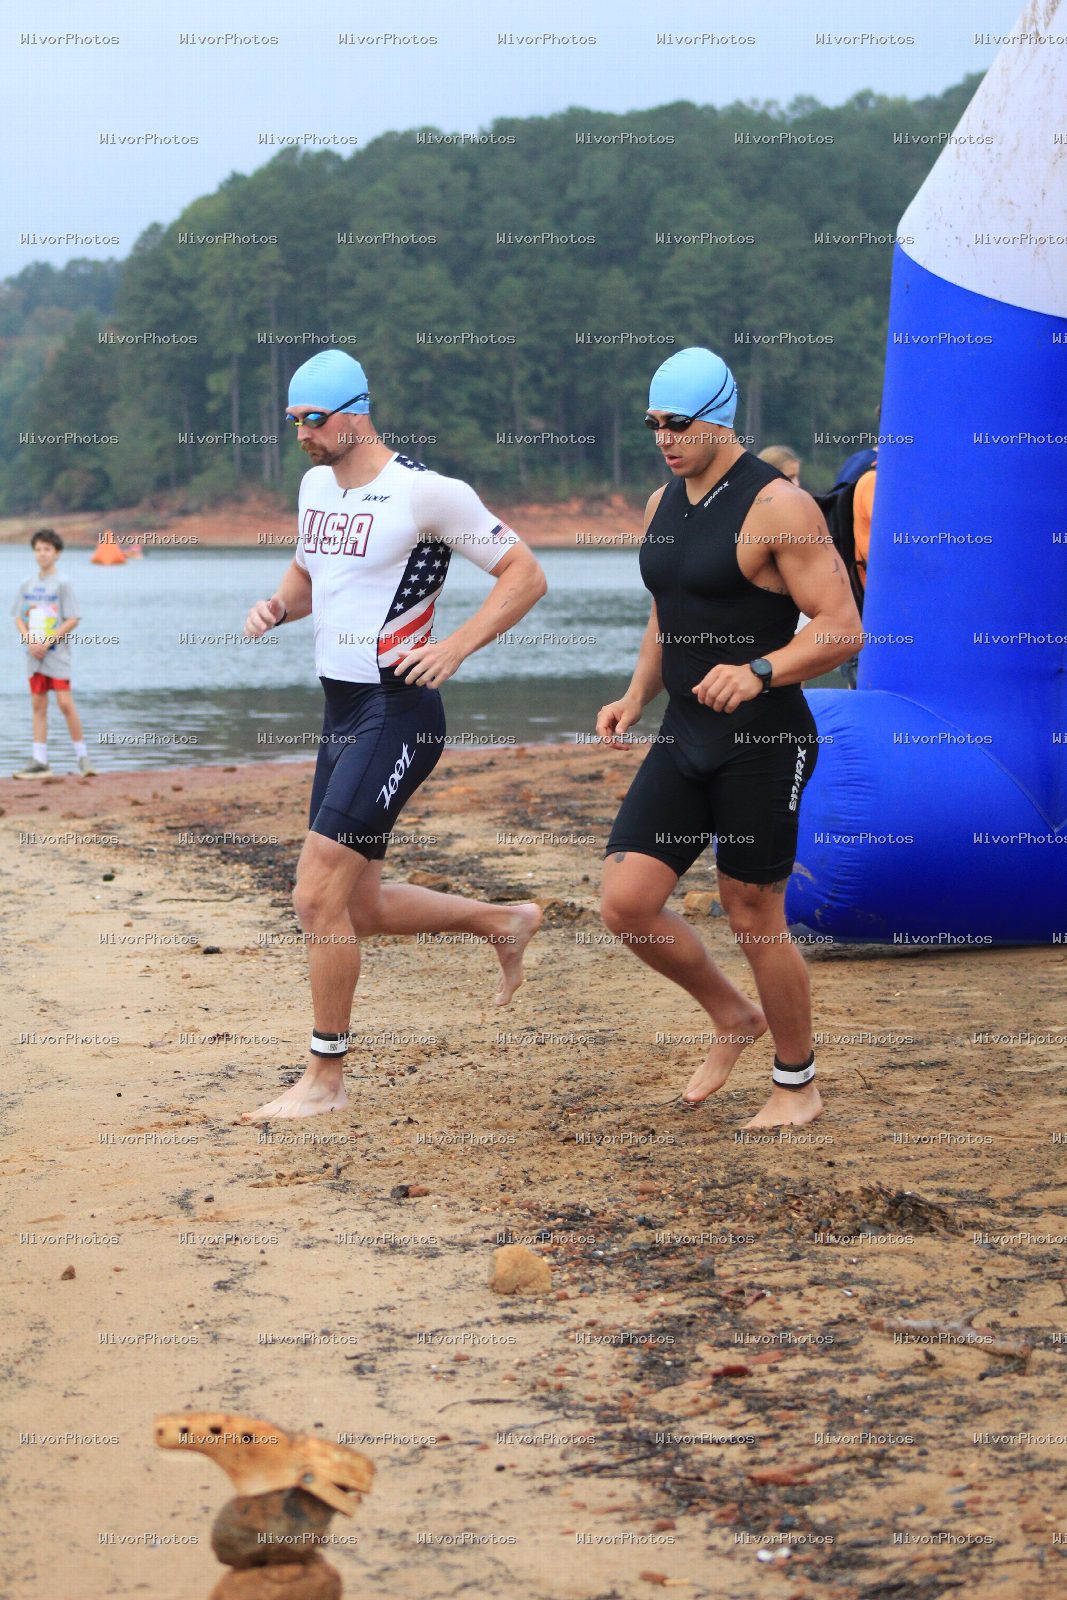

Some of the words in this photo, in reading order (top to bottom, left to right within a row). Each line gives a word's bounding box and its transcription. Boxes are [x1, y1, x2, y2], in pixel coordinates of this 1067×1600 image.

[703, 480, 730, 508] SPARX
[302, 508, 374, 557] USA
[788, 745, 807, 812] SPARX
